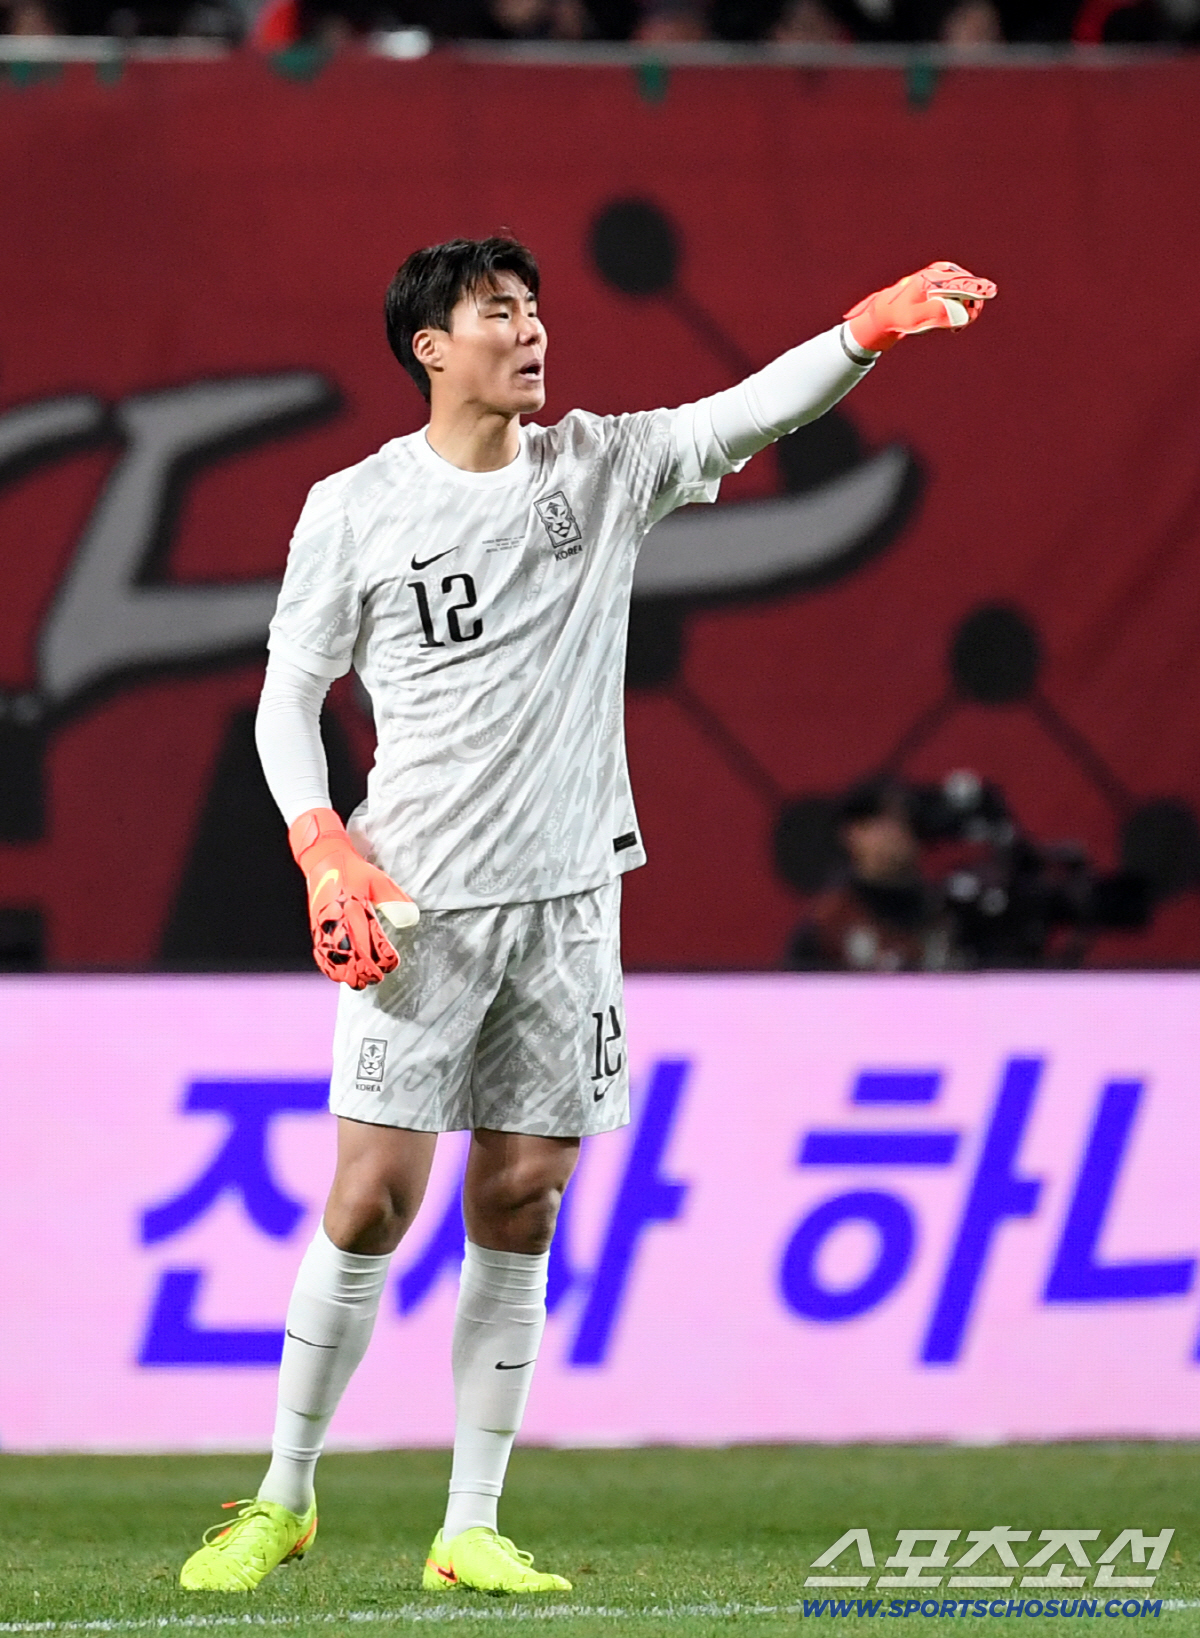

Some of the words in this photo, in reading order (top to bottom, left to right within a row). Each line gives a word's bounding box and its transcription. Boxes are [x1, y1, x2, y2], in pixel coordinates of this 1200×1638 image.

[554, 545, 583, 562] KOREA
[407, 573, 484, 649] 12
[355, 1083, 381, 1092] KOREA
